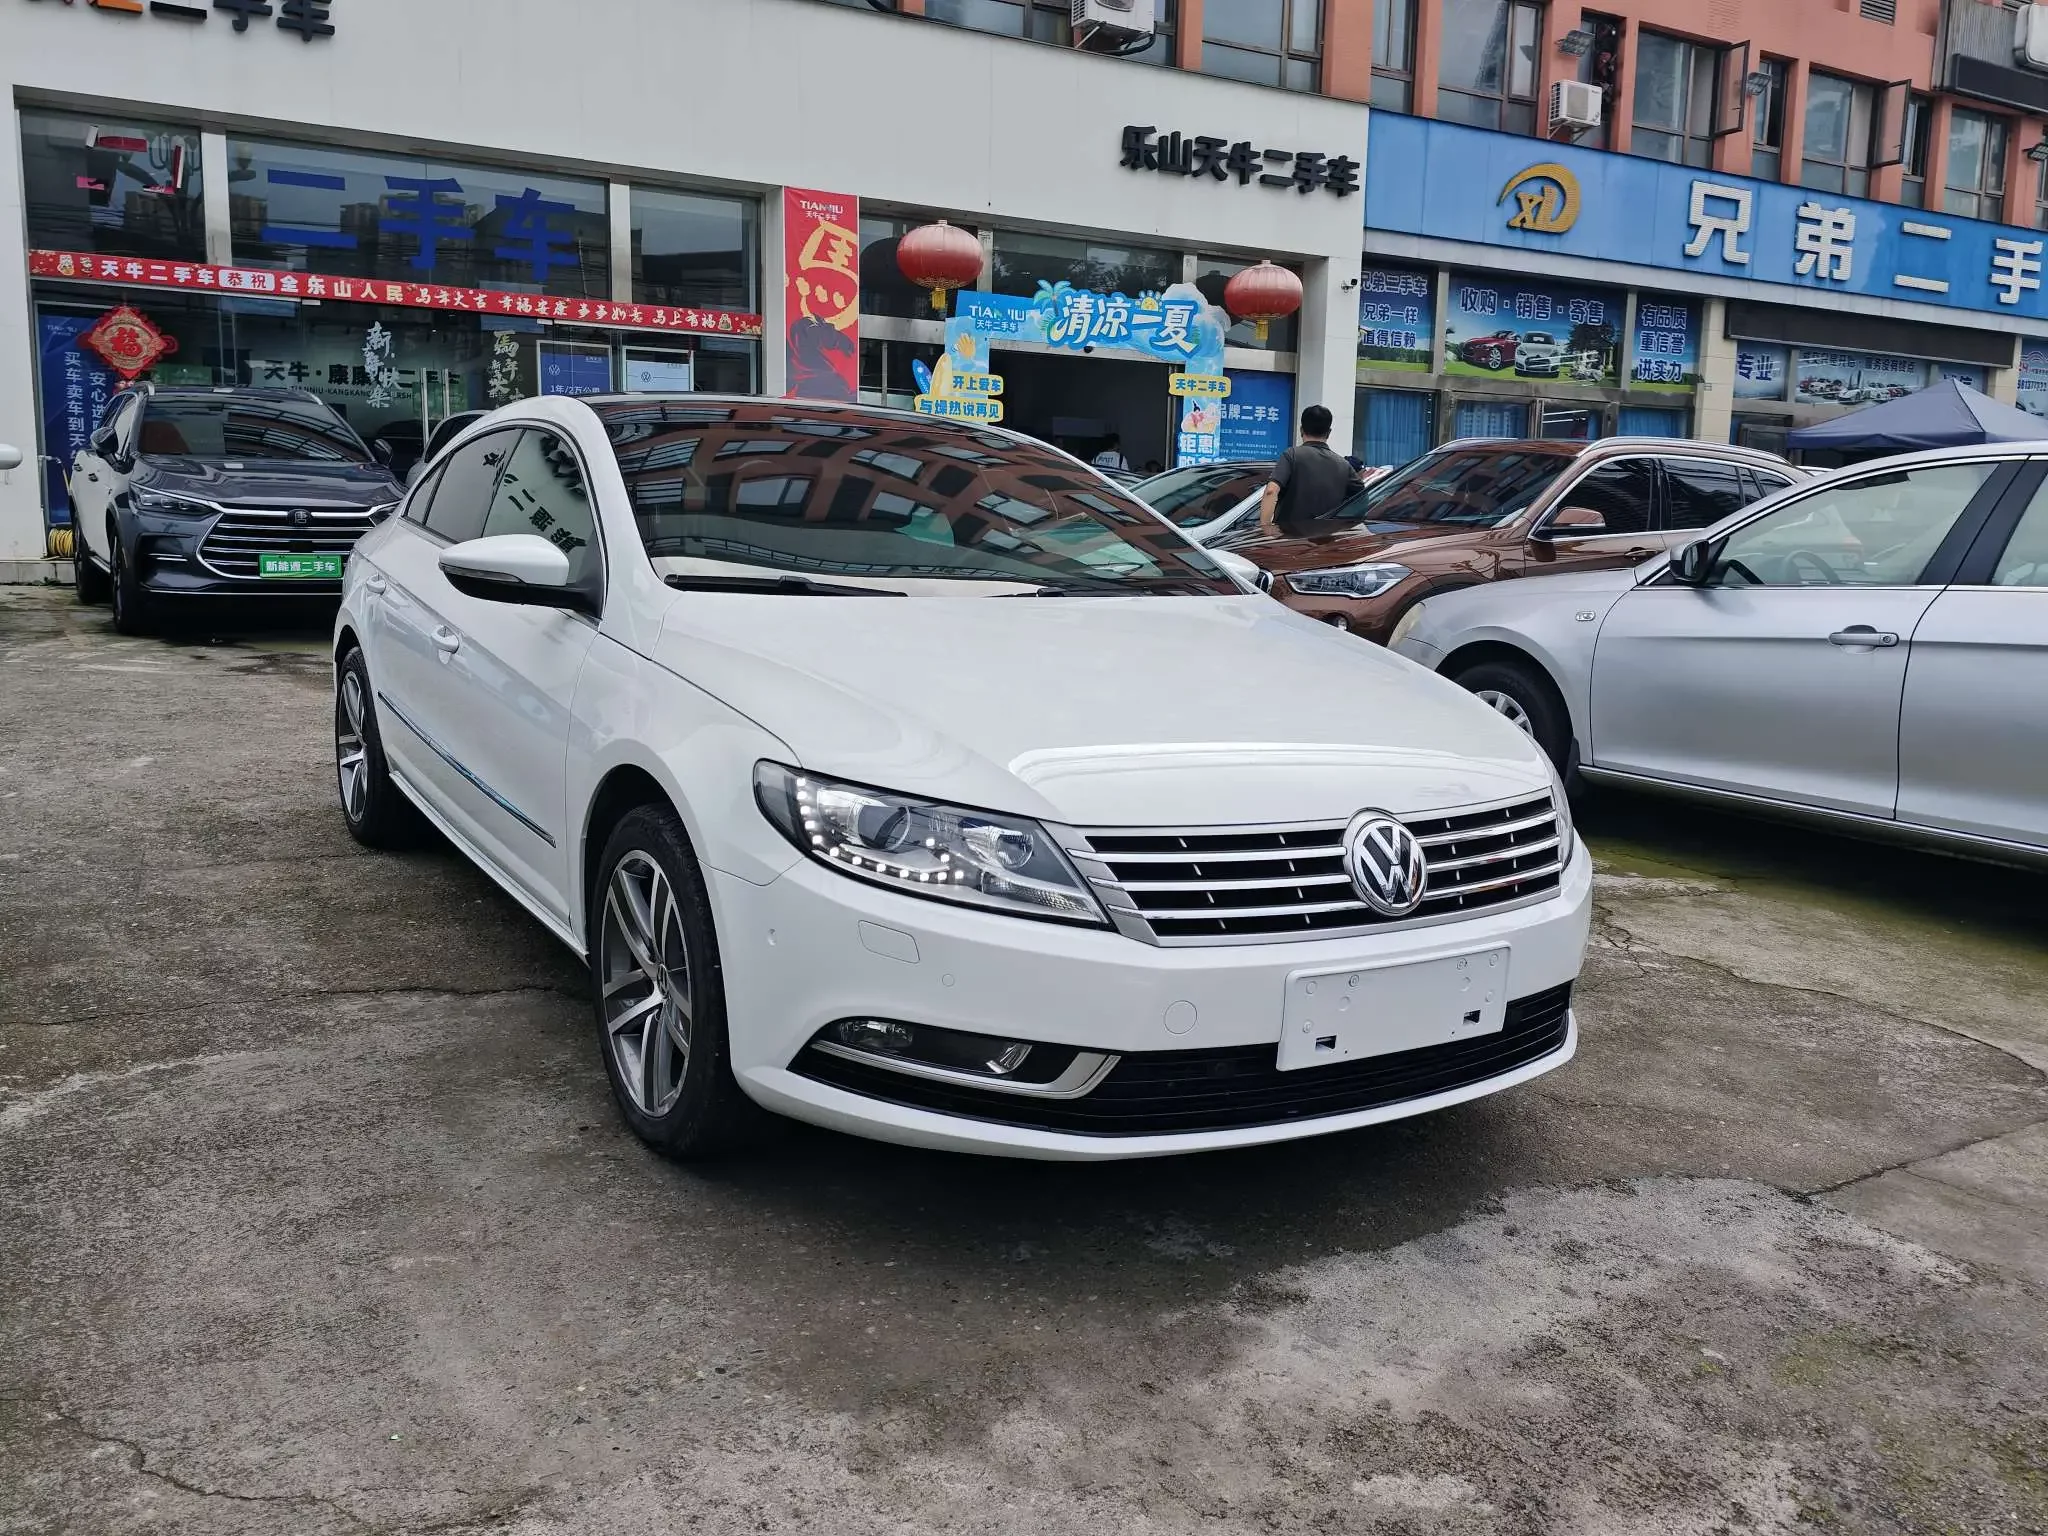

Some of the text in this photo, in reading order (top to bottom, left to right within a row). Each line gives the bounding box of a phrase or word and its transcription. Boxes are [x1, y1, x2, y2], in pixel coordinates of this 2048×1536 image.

[1120, 125, 1360, 197] 乐山天牛二手车
[262, 169, 579, 281] 二手车
[1684, 180, 2043, 305] 兄弟二手
[101, 260, 214, 285] 天牛二手车
[229, 272, 267, 290] 恭祝
[976, 319, 1017, 332] 天牛二手车
[1052, 294, 1198, 353] 清凉一夏
[1363, 302, 1418, 325] 兄弟一样
[1641, 304, 1687, 329] 有品质
[1640, 331, 1685, 355] 重信誉
[1637, 357, 1683, 382] 讲实力
[1737, 353, 1774, 380] 专业
[953, 375, 1000, 392] 开上爱车
[1176, 378, 1227, 393] 天牛二手车
[64, 352, 86, 459] 买车卖车到天
[920, 399, 999, 418] 与燥热说再见
[266, 560, 336, 572] 新能源二手车
